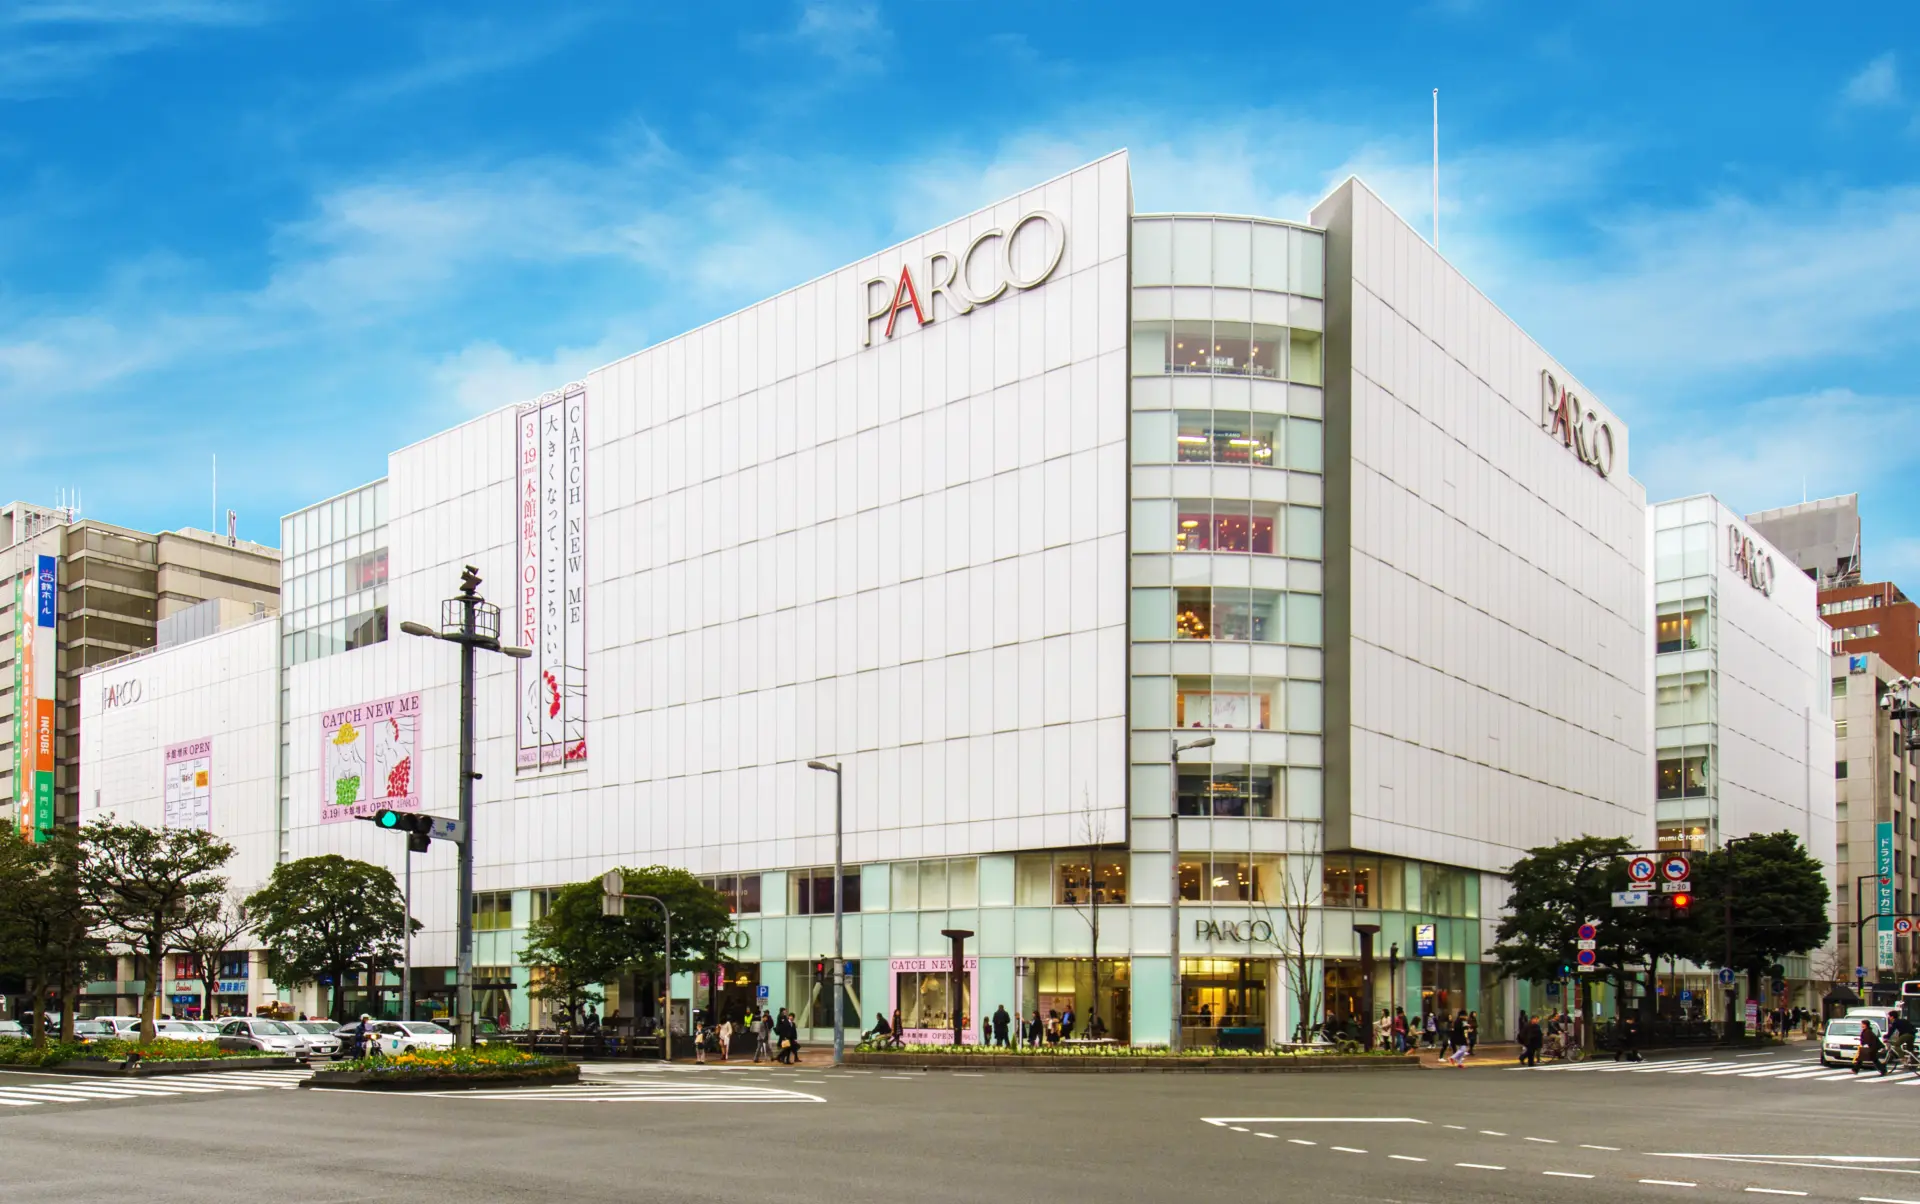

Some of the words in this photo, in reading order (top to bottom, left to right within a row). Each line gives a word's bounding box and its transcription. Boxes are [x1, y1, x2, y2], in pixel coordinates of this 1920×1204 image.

[860, 209, 1066, 347] PARCO
[1541, 368, 1615, 479] PARCO
[569, 405, 581, 505] CATCH
[568, 517, 582, 573] NEW
[1728, 524, 1775, 598] PARCO
[568, 587, 581, 624] ME
[104, 679, 142, 710] PARCO
[322, 708, 361, 729] CATCH
[366, 701, 394, 720] NEW
[399, 696, 419, 713] ME
[40, 715, 50, 756] INCUBE
[189, 741, 211, 756] OPEN
[322, 808, 338, 820] 3.19
[370, 800, 394, 813] OPEN
[1195, 919, 1272, 943] PARCO
[891, 960, 926, 971] CATCH
